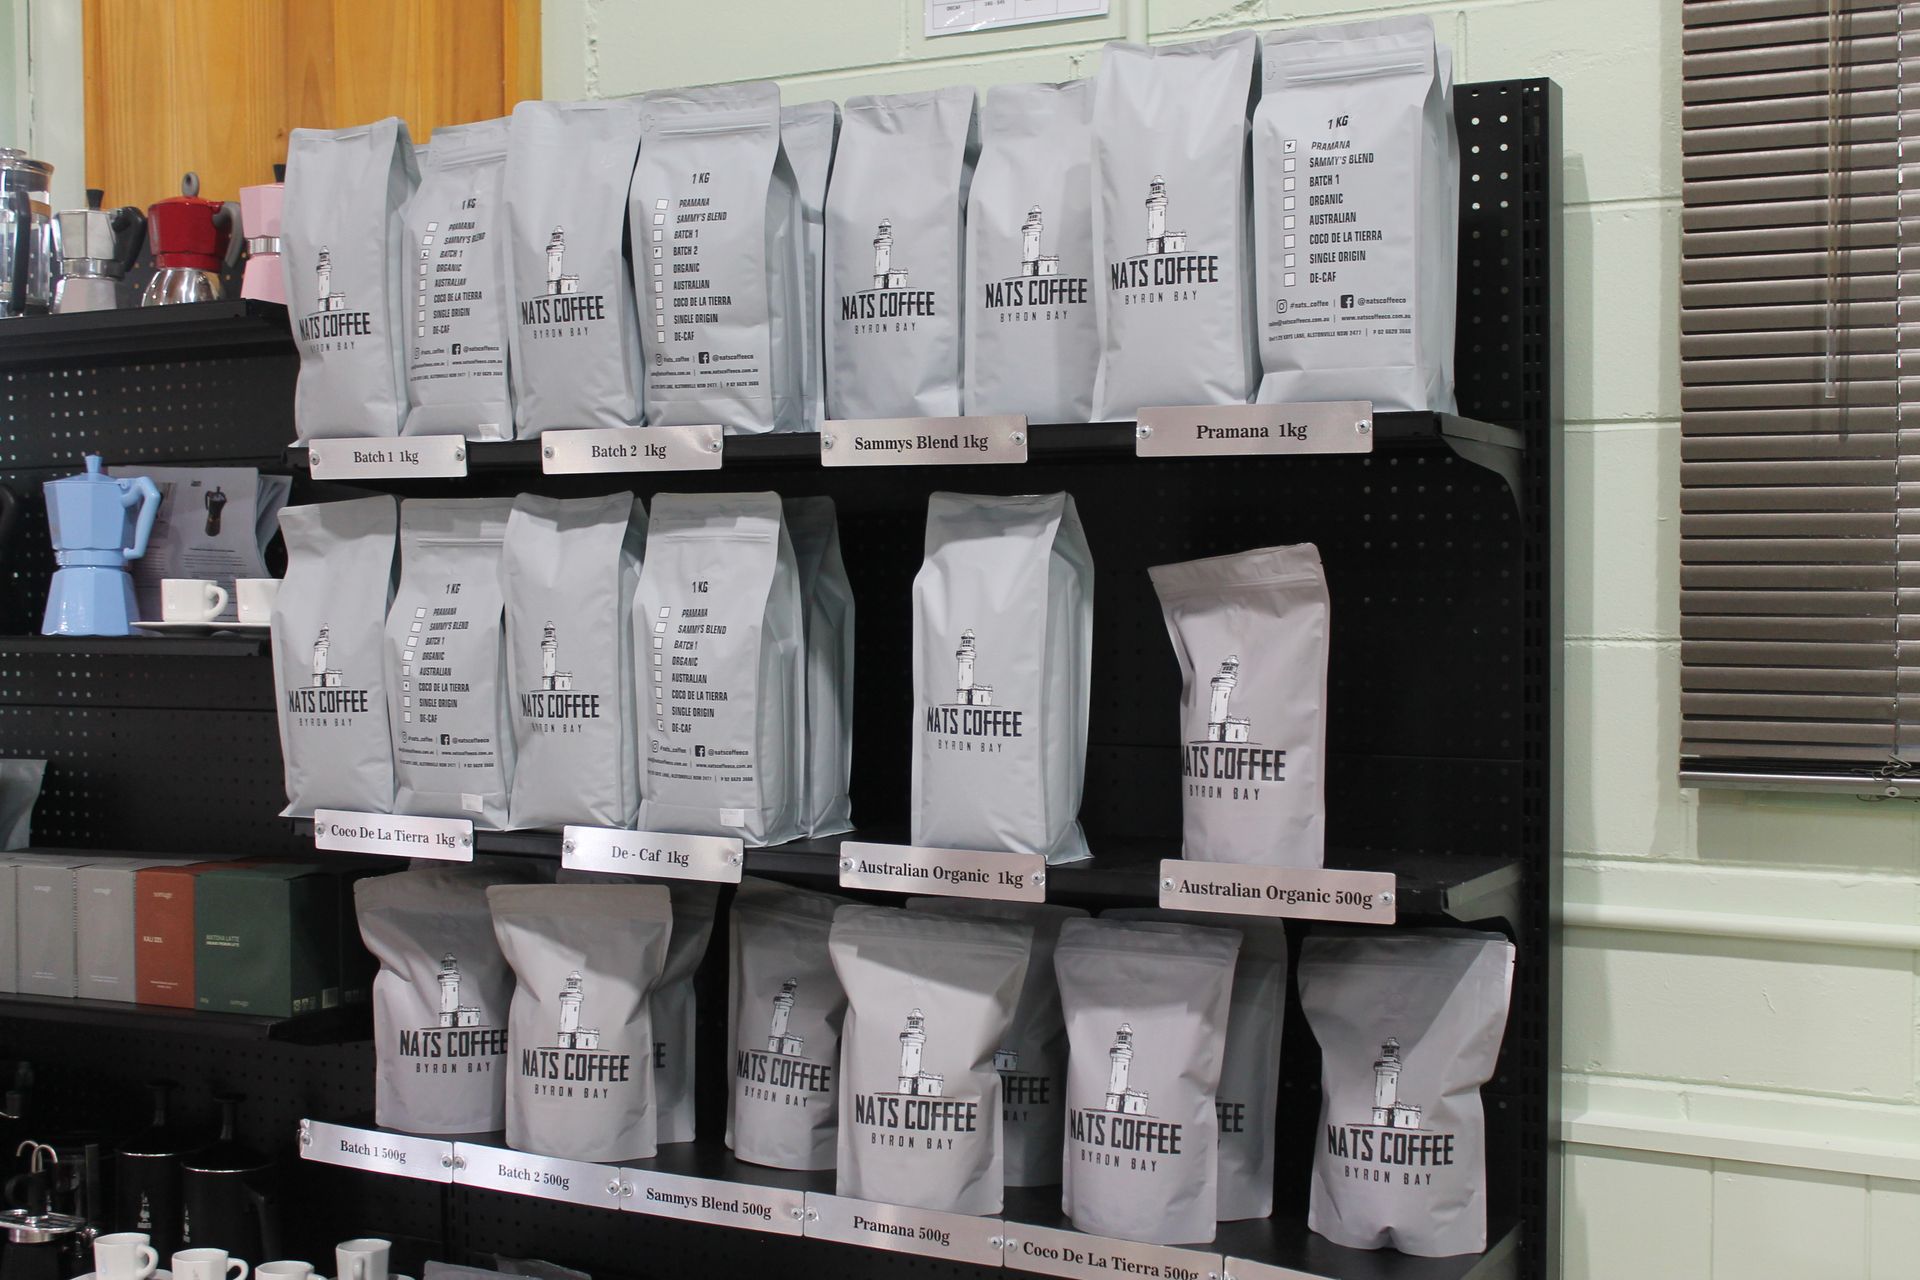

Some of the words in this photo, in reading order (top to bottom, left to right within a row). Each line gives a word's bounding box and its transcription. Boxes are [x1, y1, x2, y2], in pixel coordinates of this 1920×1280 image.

[1328, 119, 1333, 129] 1
[1336, 115, 1348, 127] KG
[1311, 140, 1350, 150] PRAMANA
[1310, 156, 1346, 167] SAMMY'S
[1349, 153, 1374, 164] BLEND
[692, 173, 696, 184] 1
[699, 173, 710, 183] KG
[1310, 175, 1332, 187] BATCH
[1335, 174, 1339, 184] 1
[679, 198, 710, 208] PRAMANA
[1310, 193, 1343, 206] ORGANIC
[677, 213, 706, 223] SAMMY'S
[707, 212, 727, 221] BLEND
[1309, 212, 1356, 225] AUSTRALIAN
[674, 230, 693, 239] BATCH
[695, 229, 698, 238] 1
[1310, 233, 1329, 244] COCO
[1332, 232, 1340, 243] DE
[1343, 231, 1352, 242] LA
[1355, 230, 1382, 241] TIERRA
[673, 246, 691, 256] BATCH
[694, 246, 698, 255] 2
[1310, 251, 1336, 264] SINGLE
[1339, 250, 1366, 262] ORIGIN
[673, 263, 700, 273] ORGANIC
[1111, 259, 1148, 290] NATS
[1154, 256, 1218, 285] COFFEE
[673, 280, 710, 290] AUSTRALIAN
[1310, 272, 1336, 283] DE-CAF
[986, 281, 1023, 308] NATS
[1029, 279, 1087, 305] COFFEE
[1125, 293, 1163, 305] BYRON
[1174, 291, 1197, 301] BAY
[673, 298, 688, 307] COCO
[690, 297, 697, 306] DE
[699, 297, 706, 306] LA
[708, 296, 731, 306] TIERRA
[842, 294, 875, 320] NATS
[880, 292, 935, 317] COFFEE
[522, 299, 550, 325] NATS
[554, 296, 605, 322] COFFEE
[1000, 312, 1036, 322] BYRON
[1047, 310, 1067, 320] BAY
[674, 314, 694, 324] SINGLE
[695, 314, 718, 323] ORIGIN
[299, 317, 320, 341] NATS
[324, 313, 371, 337] COFFEE
[534, 329, 562, 339] BYRON
[571, 327, 588, 336] BAY
[855, 324, 887, 334] BYRON
[896, 322, 916, 332] BAY
[674, 332, 694, 341] DE-CAF
[337, 341, 355, 350] BAY
[1197, 425, 1269, 439] Pramana
[1279, 423, 1307, 440] 1kg
[855, 437, 912, 452] Sammys
[917, 435, 958, 449] Blend
[963, 435, 988, 451] 1kg
[354, 451, 385, 463] Batch
[389, 452, 393, 462] 1
[400, 451, 419, 464] 1kg
[592, 445, 627, 458] Batch
[631, 445, 636, 457] 2
[645, 444, 666, 459] 1kg
[692, 582, 696, 593] 1
[699, 581, 708, 593] KG
[289, 690, 315, 712] NATS
[319, 690, 368, 713] COFFEE
[672, 690, 686, 699] COCO
[688, 690, 695, 700] DE
[697, 691, 703, 700] LA
[706, 692, 728, 701] TIERRA
[521, 694, 544, 717] NATS
[548, 695, 599, 718] COFFEE
[672, 707, 691, 717] SINGLE
[693, 708, 714, 717] ORIGIN
[299, 718, 327, 726] BYRON
[335, 718, 352, 726] BAY
[563, 724, 582, 733] BAY
[672, 723, 691, 733] DE-CAF
[927, 706, 958, 734] NATS
[963, 709, 1022, 737] COFFEE
[938, 740, 971, 751] BYRON
[981, 743, 1002, 752] BAY
[1214, 747, 1286, 781] COFFEE
[1190, 785, 1221, 798] BYRON
[1234, 788, 1260, 800] BAY
[332, 824, 356, 838] Coco
[360, 827, 374, 839] De
[378, 829, 391, 840] La
[395, 830, 429, 843] Tierra
[436, 833, 455, 848] 1kg
[612, 846, 628, 858] De
[639, 848, 662, 862] Caf
[667, 851, 689, 867] 1kg
[858, 860, 929, 878] Australian
[933, 866, 989, 884] Organic
[998, 872, 1024, 888] 1kg
[1179, 880, 1261, 899] Australian
[1266, 885, 1330, 904] Organic
[1335, 891, 1373, 909] 500g
[400, 1030, 441, 1057] NATS
[448, 1029, 508, 1057] COFFEE
[416, 1063, 456, 1073] BYRON
[468, 1062, 490, 1072] BAY
[522, 1048, 559, 1080] NATS
[564, 1054, 630, 1082] COFFEE
[737, 1050, 767, 1082] NATS
[770, 1058, 831, 1092] COFFEE
[535, 1083, 573, 1097] BYRON
[584, 1087, 608, 1098] BAY
[745, 1086, 776, 1102] BYRON
[786, 1094, 807, 1107] BAY
[1001, 1075, 1050, 1104] FFEE
[855, 1094, 899, 1128] NATS
[905, 1099, 977, 1132] COFFEE
[1070, 1108, 1105, 1146] NATS
[1111, 1118, 1182, 1154] COFFEE
[871, 1132, 914, 1149] BYRON
[927, 1137, 953, 1150] BAY
[1328, 1124, 1373, 1162] NATS
[1380, 1132, 1454, 1166] COFFEE
[340, 1140, 370, 1156] Batch
[374, 1147, 378, 1157] 1
[382, 1148, 406, 1163] 500g
[1081, 1149, 1120, 1168] BYRON
[1131, 1158, 1157, 1172] BAY
[498, 1164, 530, 1180] Batch
[534, 1172, 540, 1182] 2
[543, 1174, 570, 1190] 500g
[1345, 1166, 1390, 1183] BYRON
[1404, 1173, 1431, 1185] BAY
[647, 1188, 698, 1208] Sammys
[701, 1196, 739, 1214] Blend
[742, 1201, 772, 1219] 500g
[853, 1216, 914, 1238] Pramana
[918, 1227, 951, 1246] 500g
[1023, 1241, 1058, 1259] Coco
[1063, 1250, 1083, 1263] De
[1088, 1252, 1107, 1267] La
[1111, 1256, 1159, 1277] Tierra
[1164, 1266, 1199, 1280] 500g
